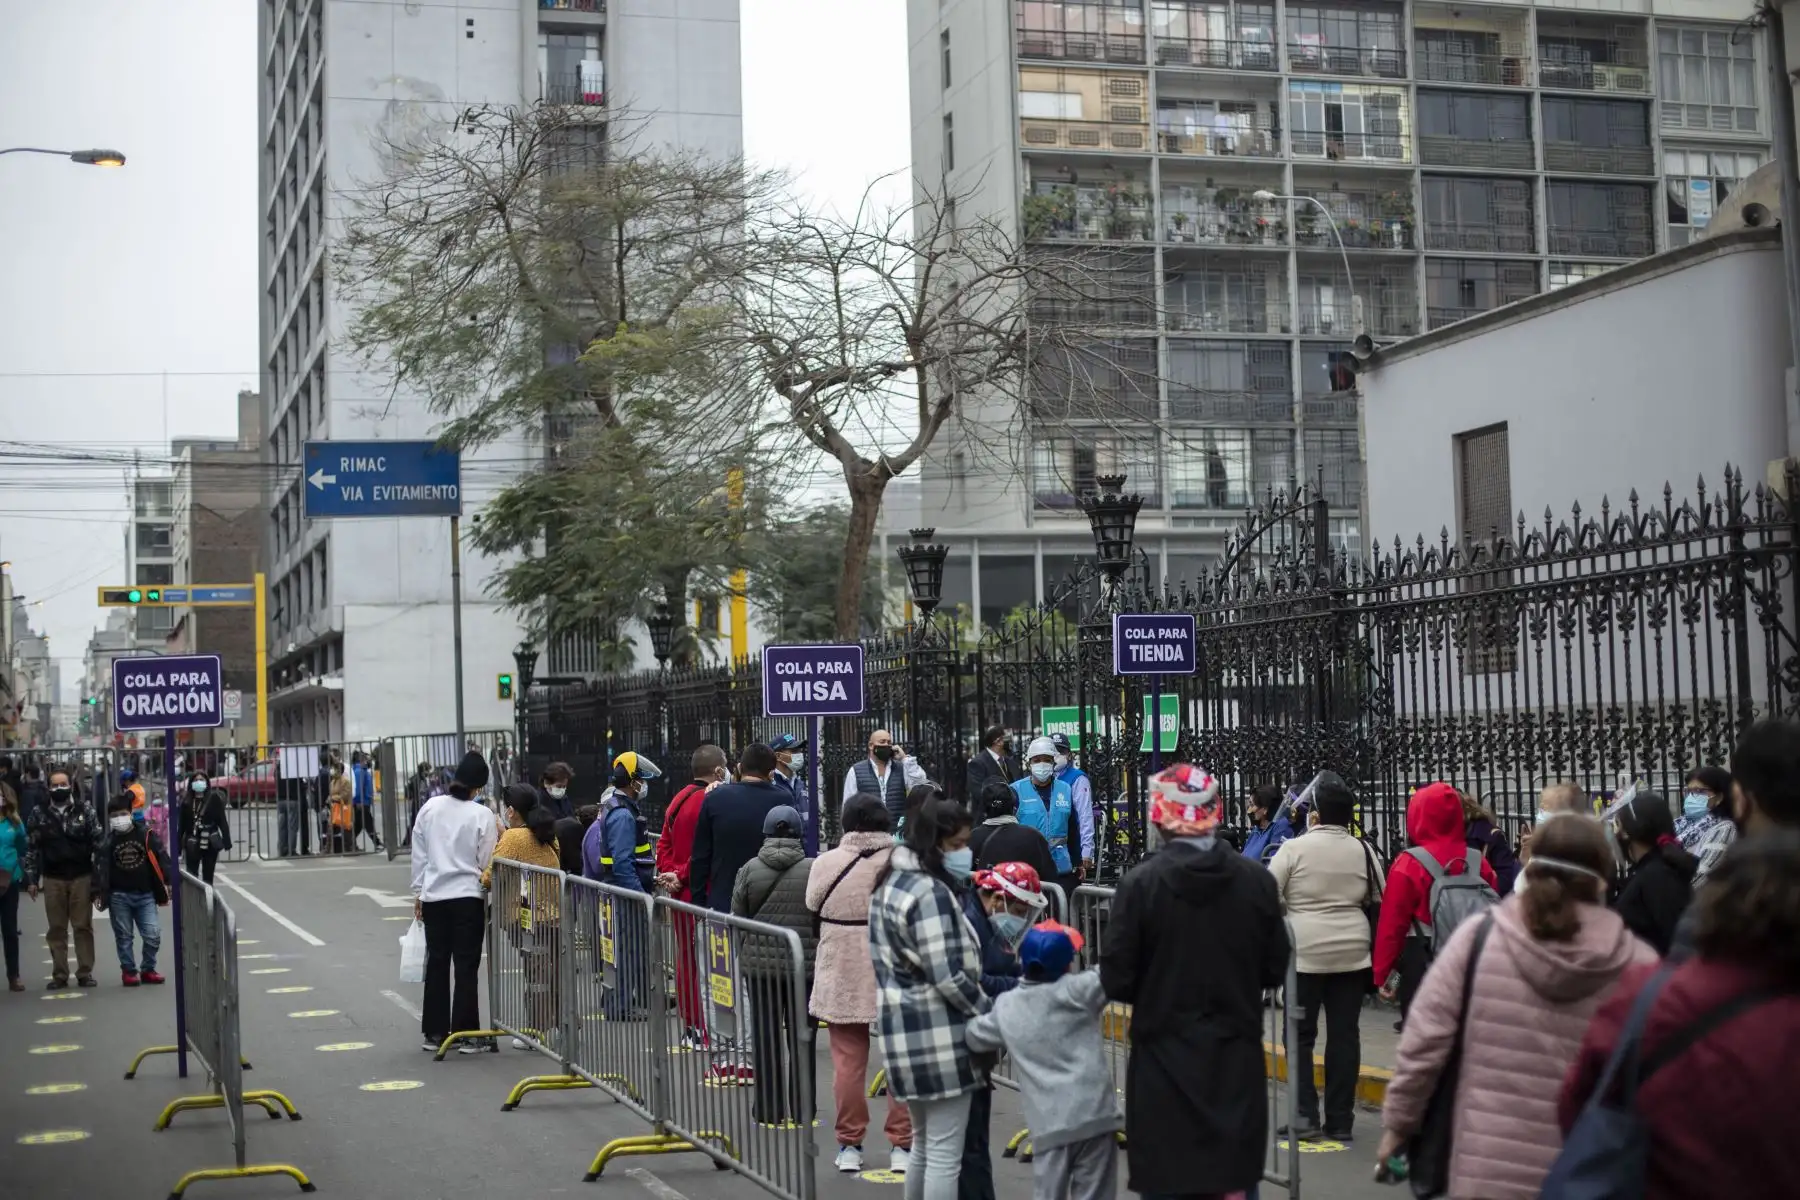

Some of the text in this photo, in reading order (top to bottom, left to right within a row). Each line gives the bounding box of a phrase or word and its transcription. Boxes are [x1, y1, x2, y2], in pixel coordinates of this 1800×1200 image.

[340, 456, 386, 472] RIMAC
[341, 484, 458, 501] VIA EVITAMIENTO
[1125, 628, 1188, 639] COLA PARA
[1129, 644, 1184, 662] TIENDA
[775, 661, 854, 675] COLA PARA
[124, 672, 211, 688] COLA PARA
[782, 680, 848, 702] MISA
[122, 687, 215, 716] ORACIÓN
[1046, 720, 1092, 736] INGREO
[1147, 714, 1176, 732] IRESO
